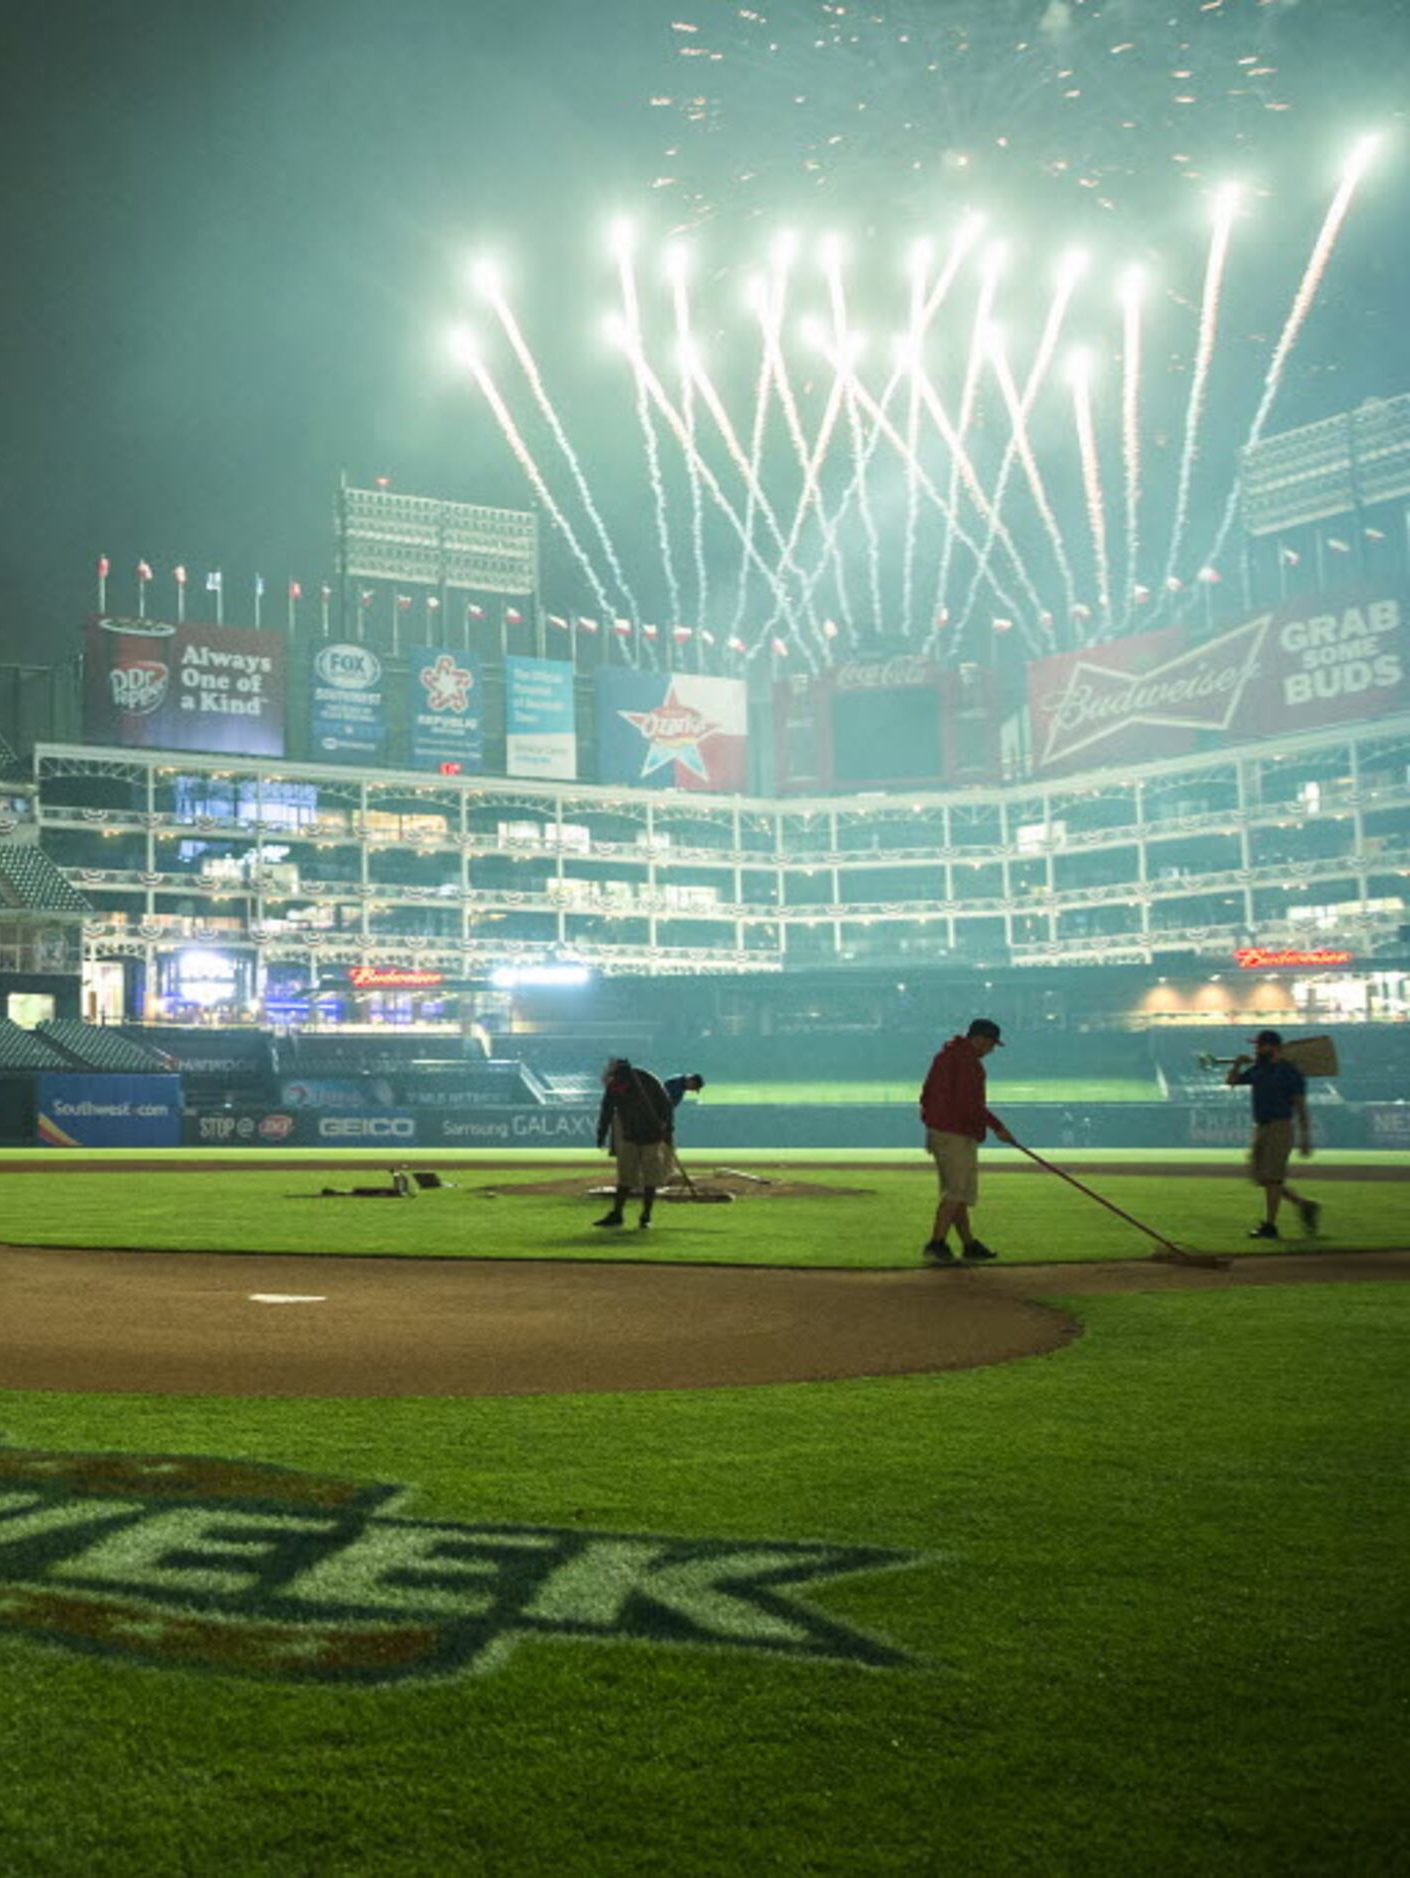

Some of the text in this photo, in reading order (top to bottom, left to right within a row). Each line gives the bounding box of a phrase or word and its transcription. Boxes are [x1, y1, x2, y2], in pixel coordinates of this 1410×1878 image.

[1280, 599, 1399, 652] GRAB
[181, 645, 272, 673] Always
[330, 653, 365, 671] FOX
[1302, 636, 1381, 669] SOME
[181, 668, 263, 693] One of
[1282, 654, 1403, 705] BUDS
[180, 694, 195, 711] a
[1041, 663, 1261, 729] Budweiser
[199, 1116, 235, 1138] STOP
[318, 1117, 415, 1137] GEICO
[442, 1120, 509, 1138] Samsung
